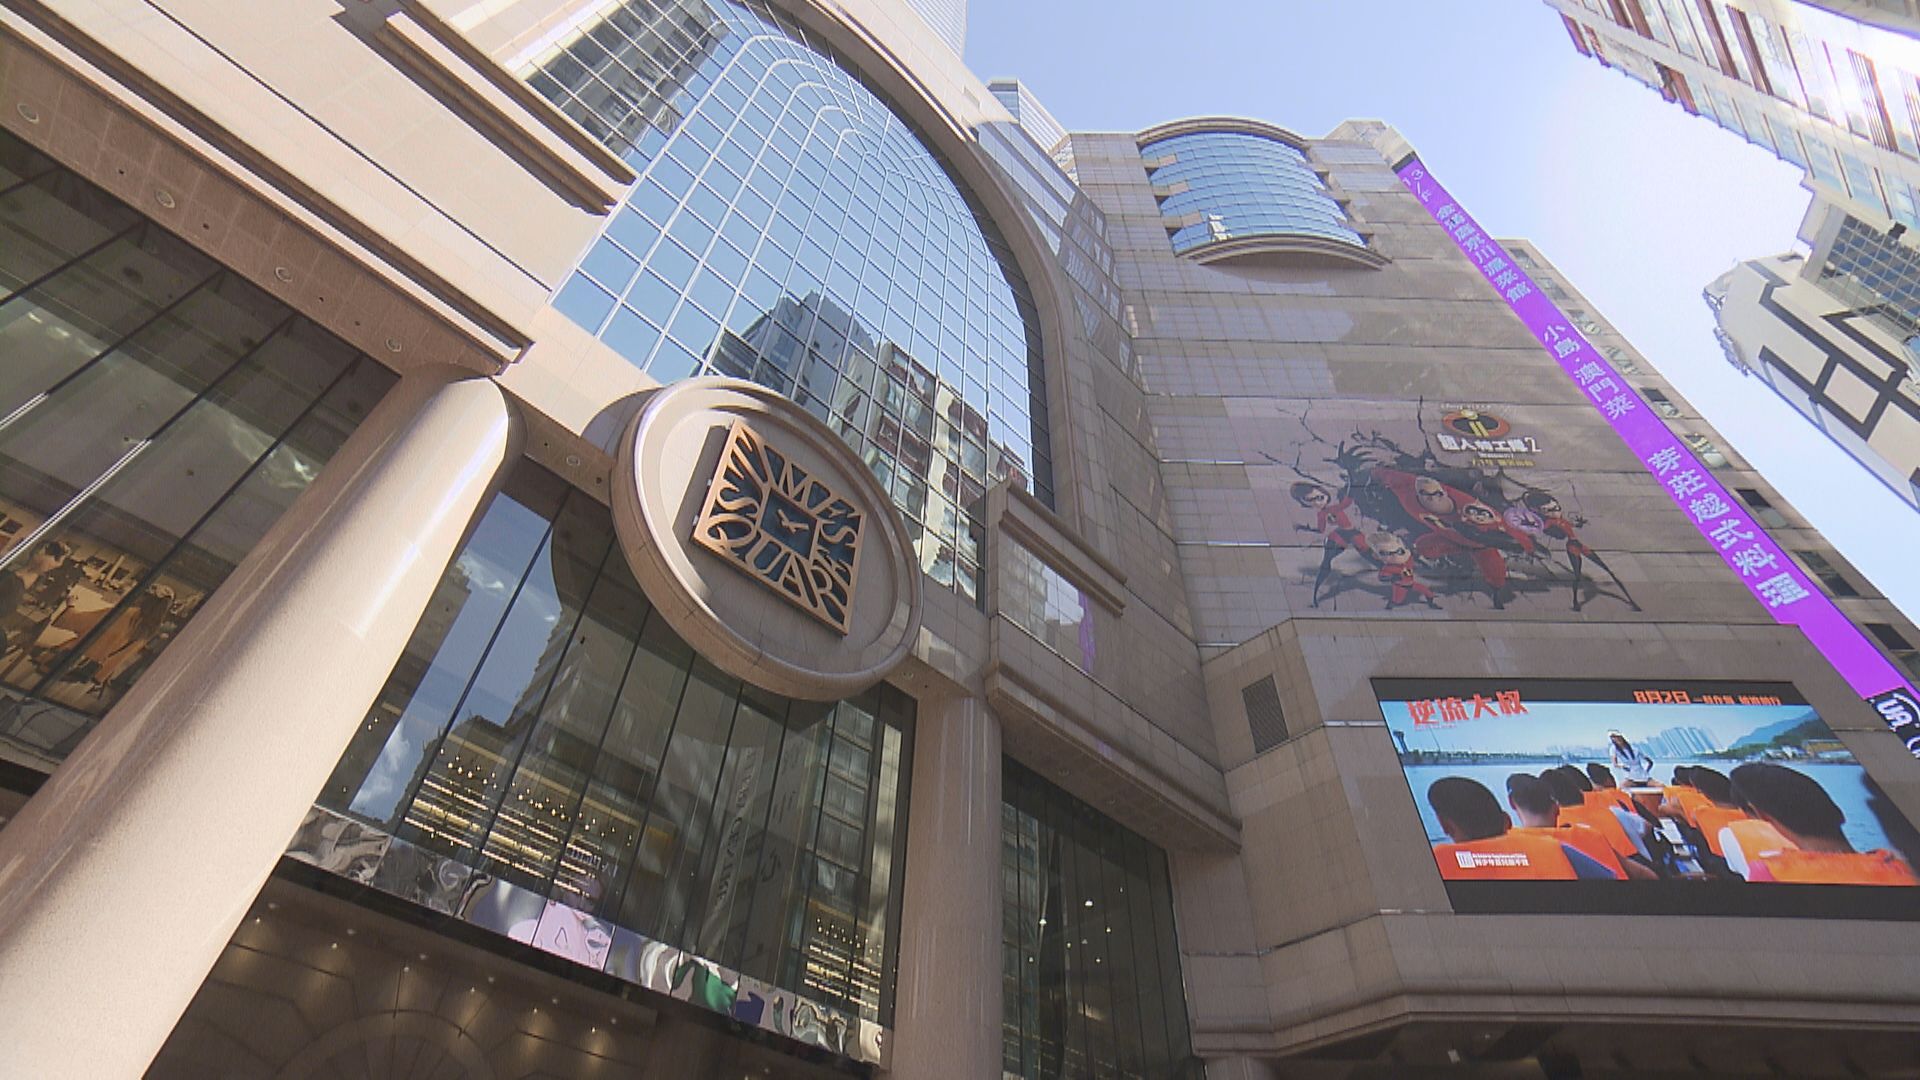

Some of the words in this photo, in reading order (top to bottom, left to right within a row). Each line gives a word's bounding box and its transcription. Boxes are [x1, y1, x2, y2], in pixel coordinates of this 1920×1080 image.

[696, 476, 852, 632] SQUARE
[722, 420, 866, 547] TIMES
[1648, 446, 1809, 608] 芽莊越式料理
[1407, 688, 1528, 726] 逆流大叔
